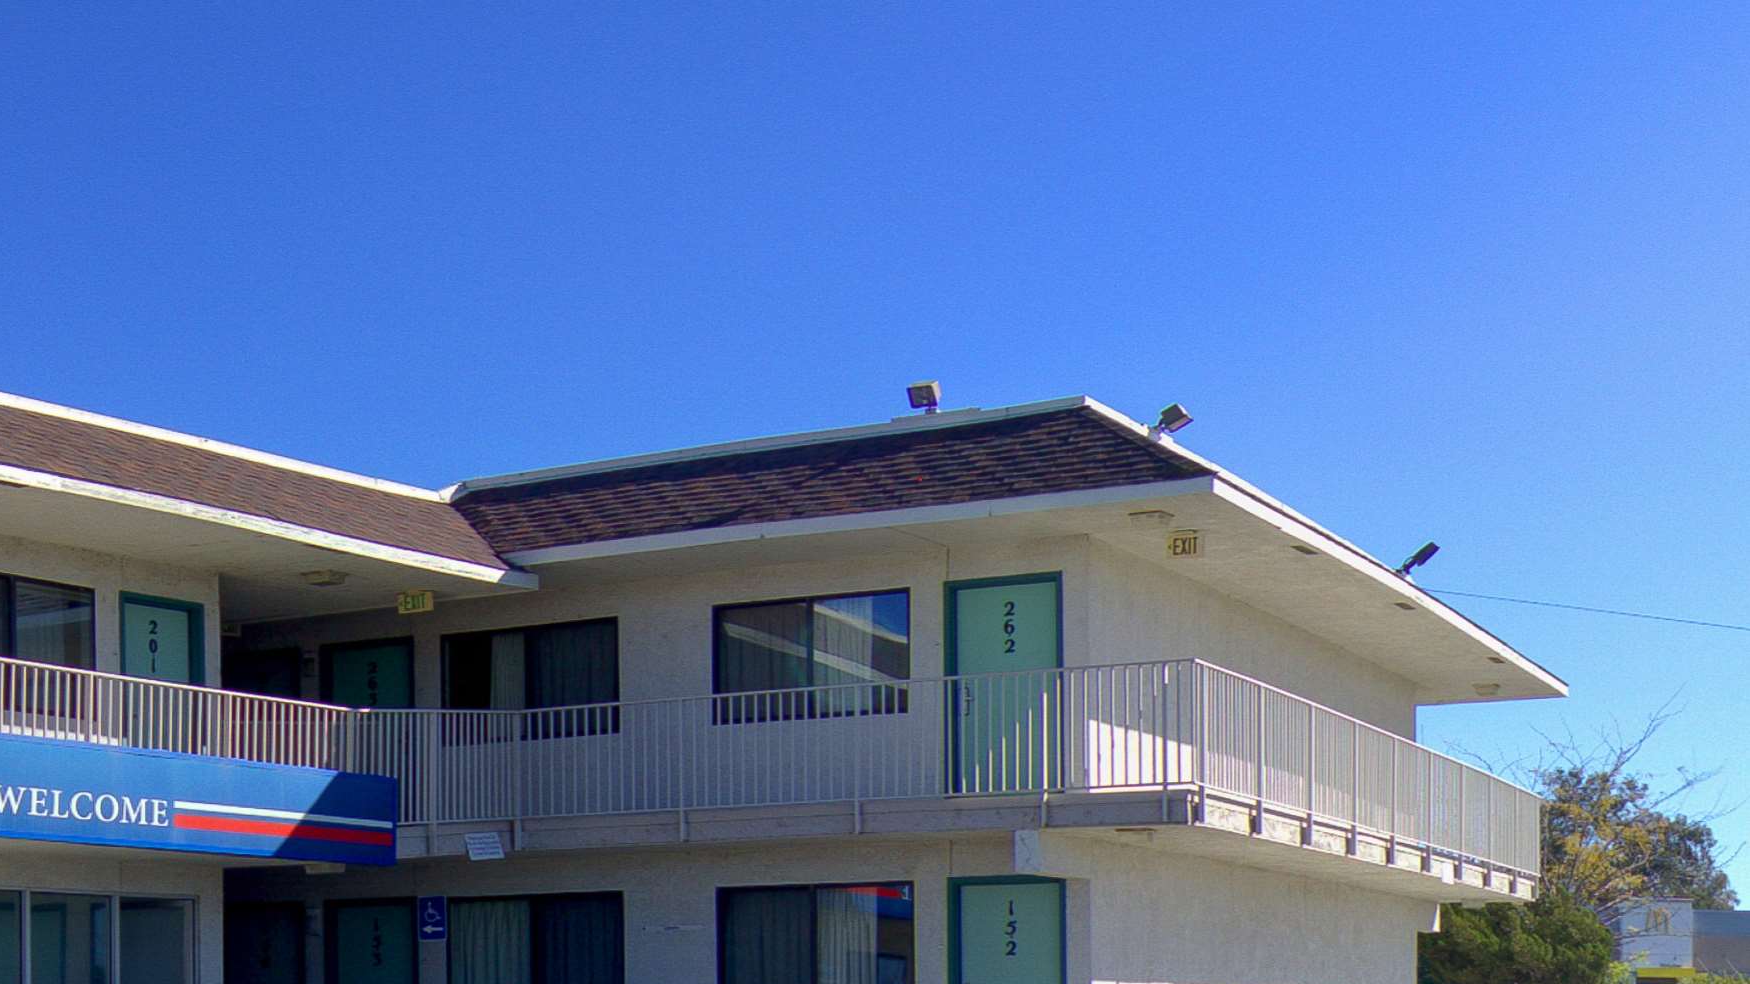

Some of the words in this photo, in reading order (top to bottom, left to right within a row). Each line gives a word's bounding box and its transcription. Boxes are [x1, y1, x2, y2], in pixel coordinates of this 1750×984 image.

[1173, 537, 1198, 555] EXIT
[403, 592, 426, 611] EXIT
[1003, 601, 1016, 654] 262
[148, 620, 159, 674] 201
[1004, 900, 1017, 956] 152
